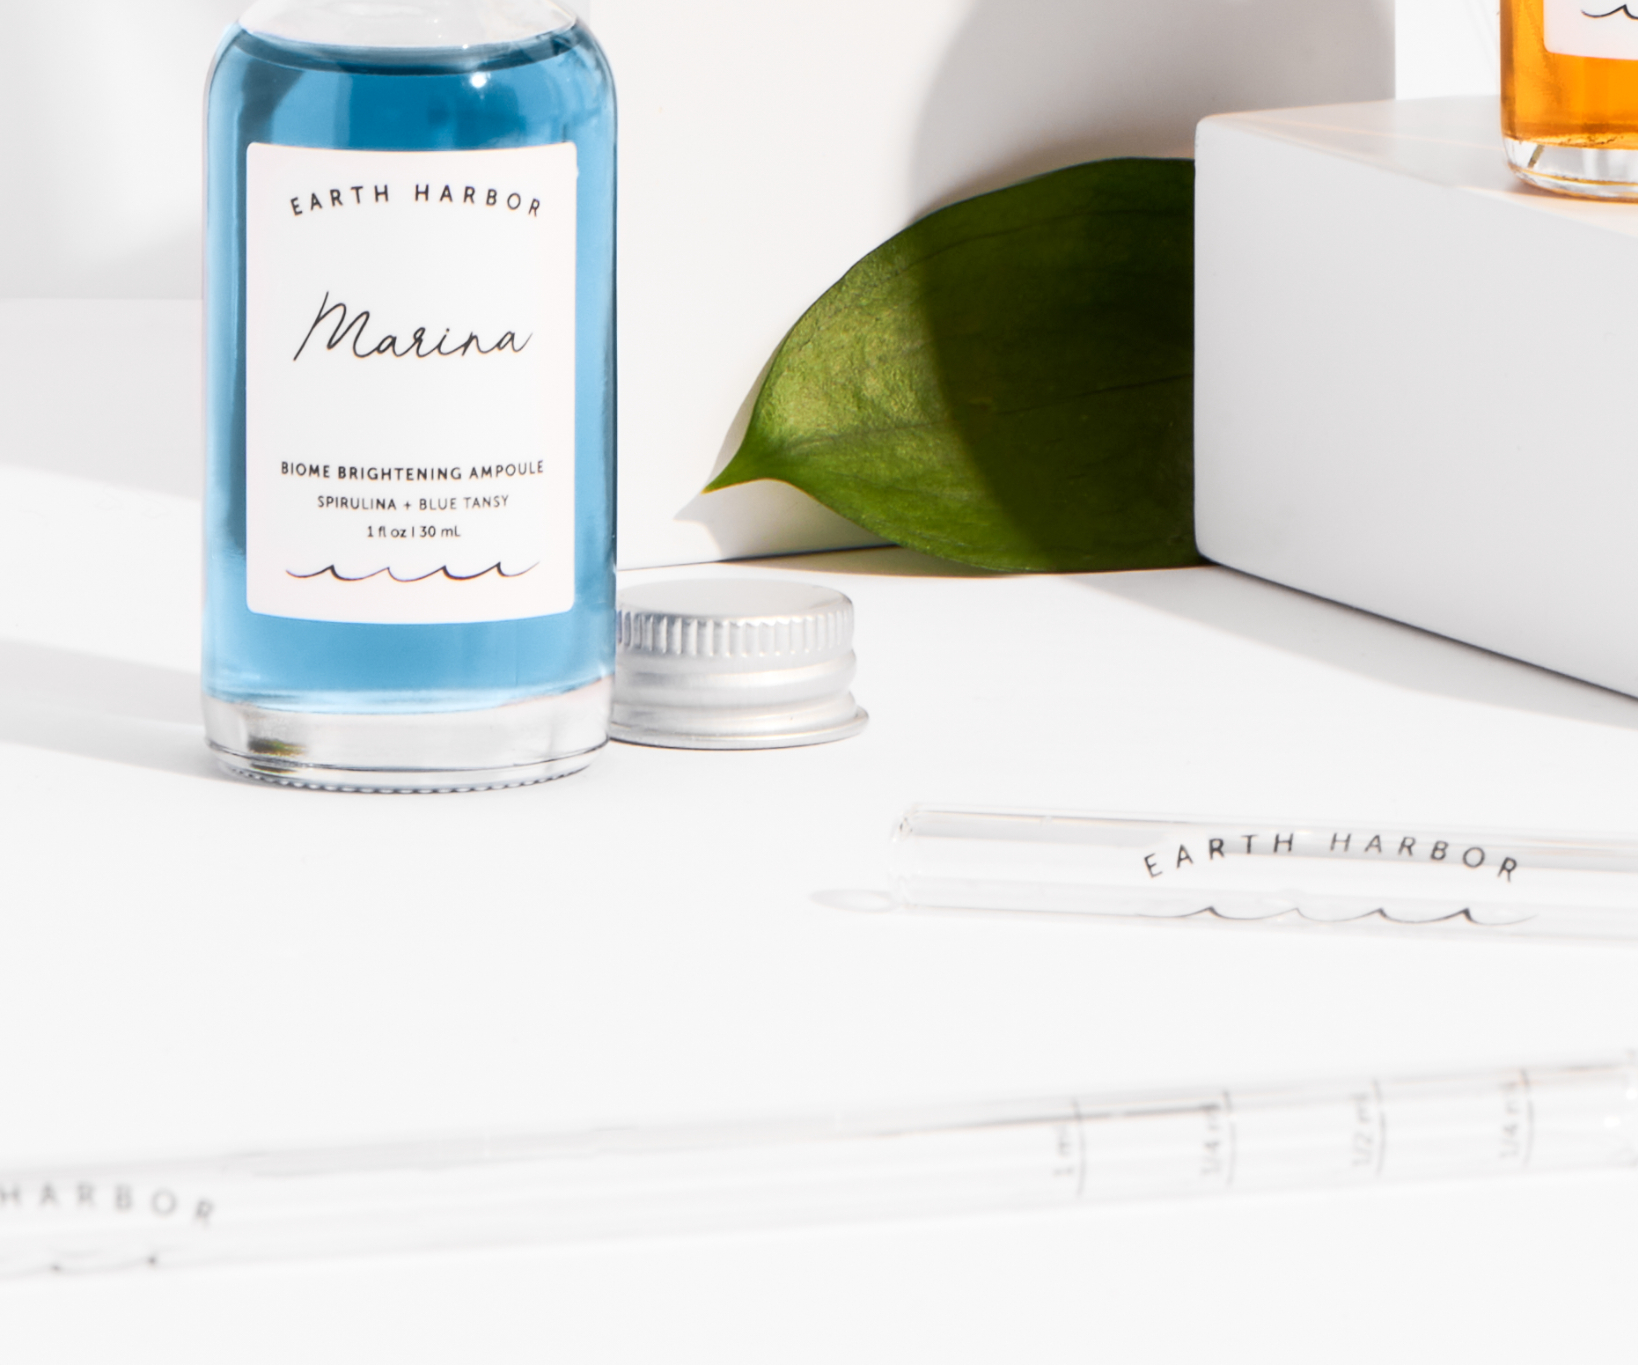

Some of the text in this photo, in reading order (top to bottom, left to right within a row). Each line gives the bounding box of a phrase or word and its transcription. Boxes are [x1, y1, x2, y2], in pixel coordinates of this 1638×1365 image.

[289, 183, 541, 217] EARTH HARBOR
[292, 291, 534, 362] Marina
[281, 460, 543, 482] BIOME BRIGHTENING AMPOULE
[317, 494, 509, 511] SPIRULINA + BLUE TANSY
[367, 525, 374, 539] 1
[377, 525, 387, 538] fl
[390, 528, 407, 539] oz
[419, 524, 437, 539] 30
[440, 525, 461, 538] mL
[1144, 832, 1518, 882] EARTH HARBOR
[0, 1182, 215, 1230] HARBOR
